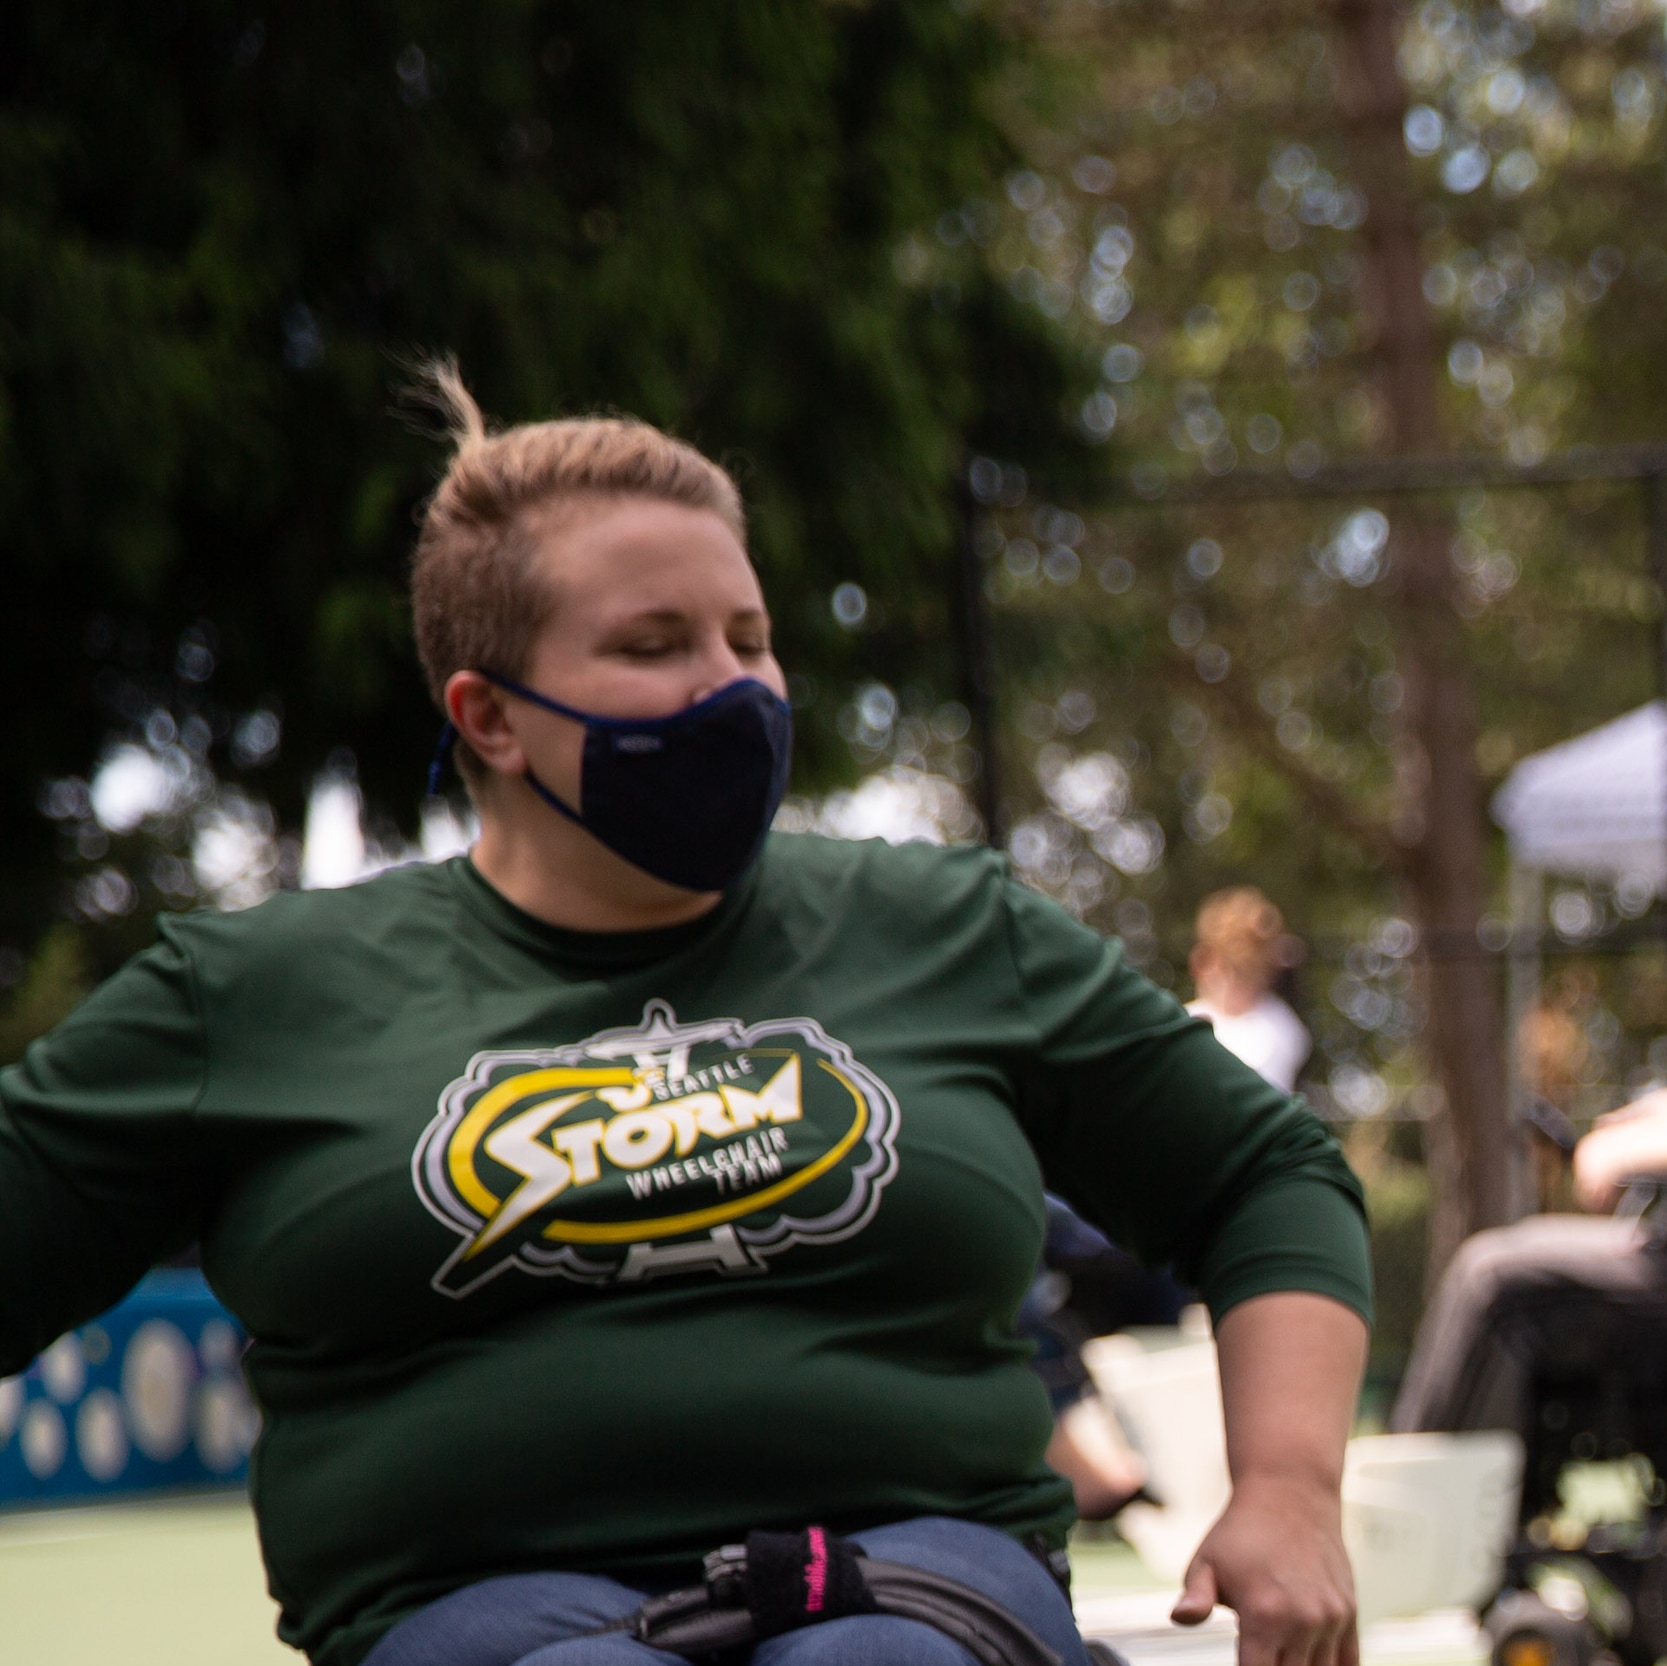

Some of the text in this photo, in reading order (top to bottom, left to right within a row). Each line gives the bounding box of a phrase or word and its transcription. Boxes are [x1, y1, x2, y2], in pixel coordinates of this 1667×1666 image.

[652, 1053, 753, 1101] SEATTLE
[462, 1053, 802, 1262] STORM
[625, 1127, 789, 1200] WHEELCHAIR
[710, 1152, 783, 1196] TEAM
